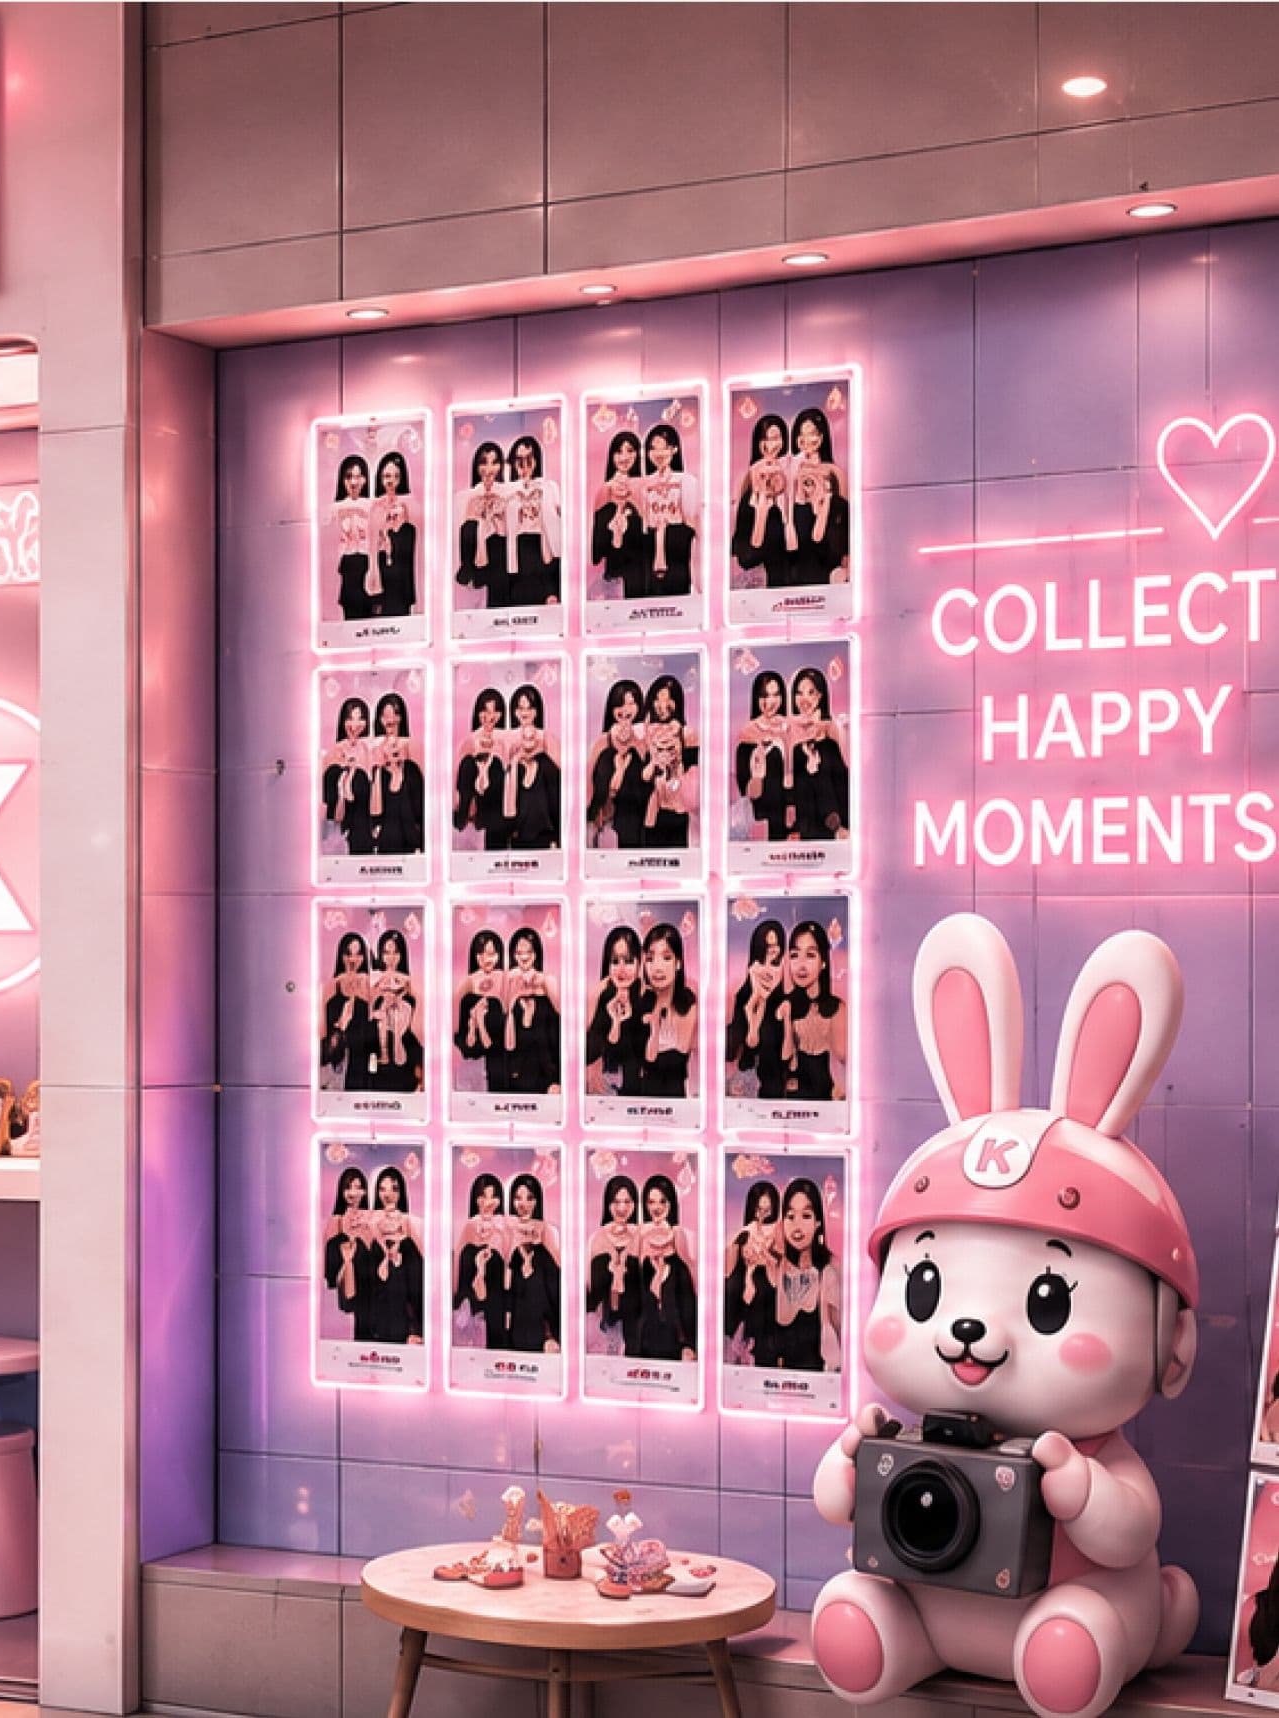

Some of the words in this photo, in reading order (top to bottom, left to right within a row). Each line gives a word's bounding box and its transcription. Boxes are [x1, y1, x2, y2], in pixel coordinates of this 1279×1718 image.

[931, 568, 1279, 657] COLLECT
[981, 684, 1233, 761] HAPPY
[914, 790, 1279, 866] MOMENTS
[975, 1137, 1020, 1175] K
